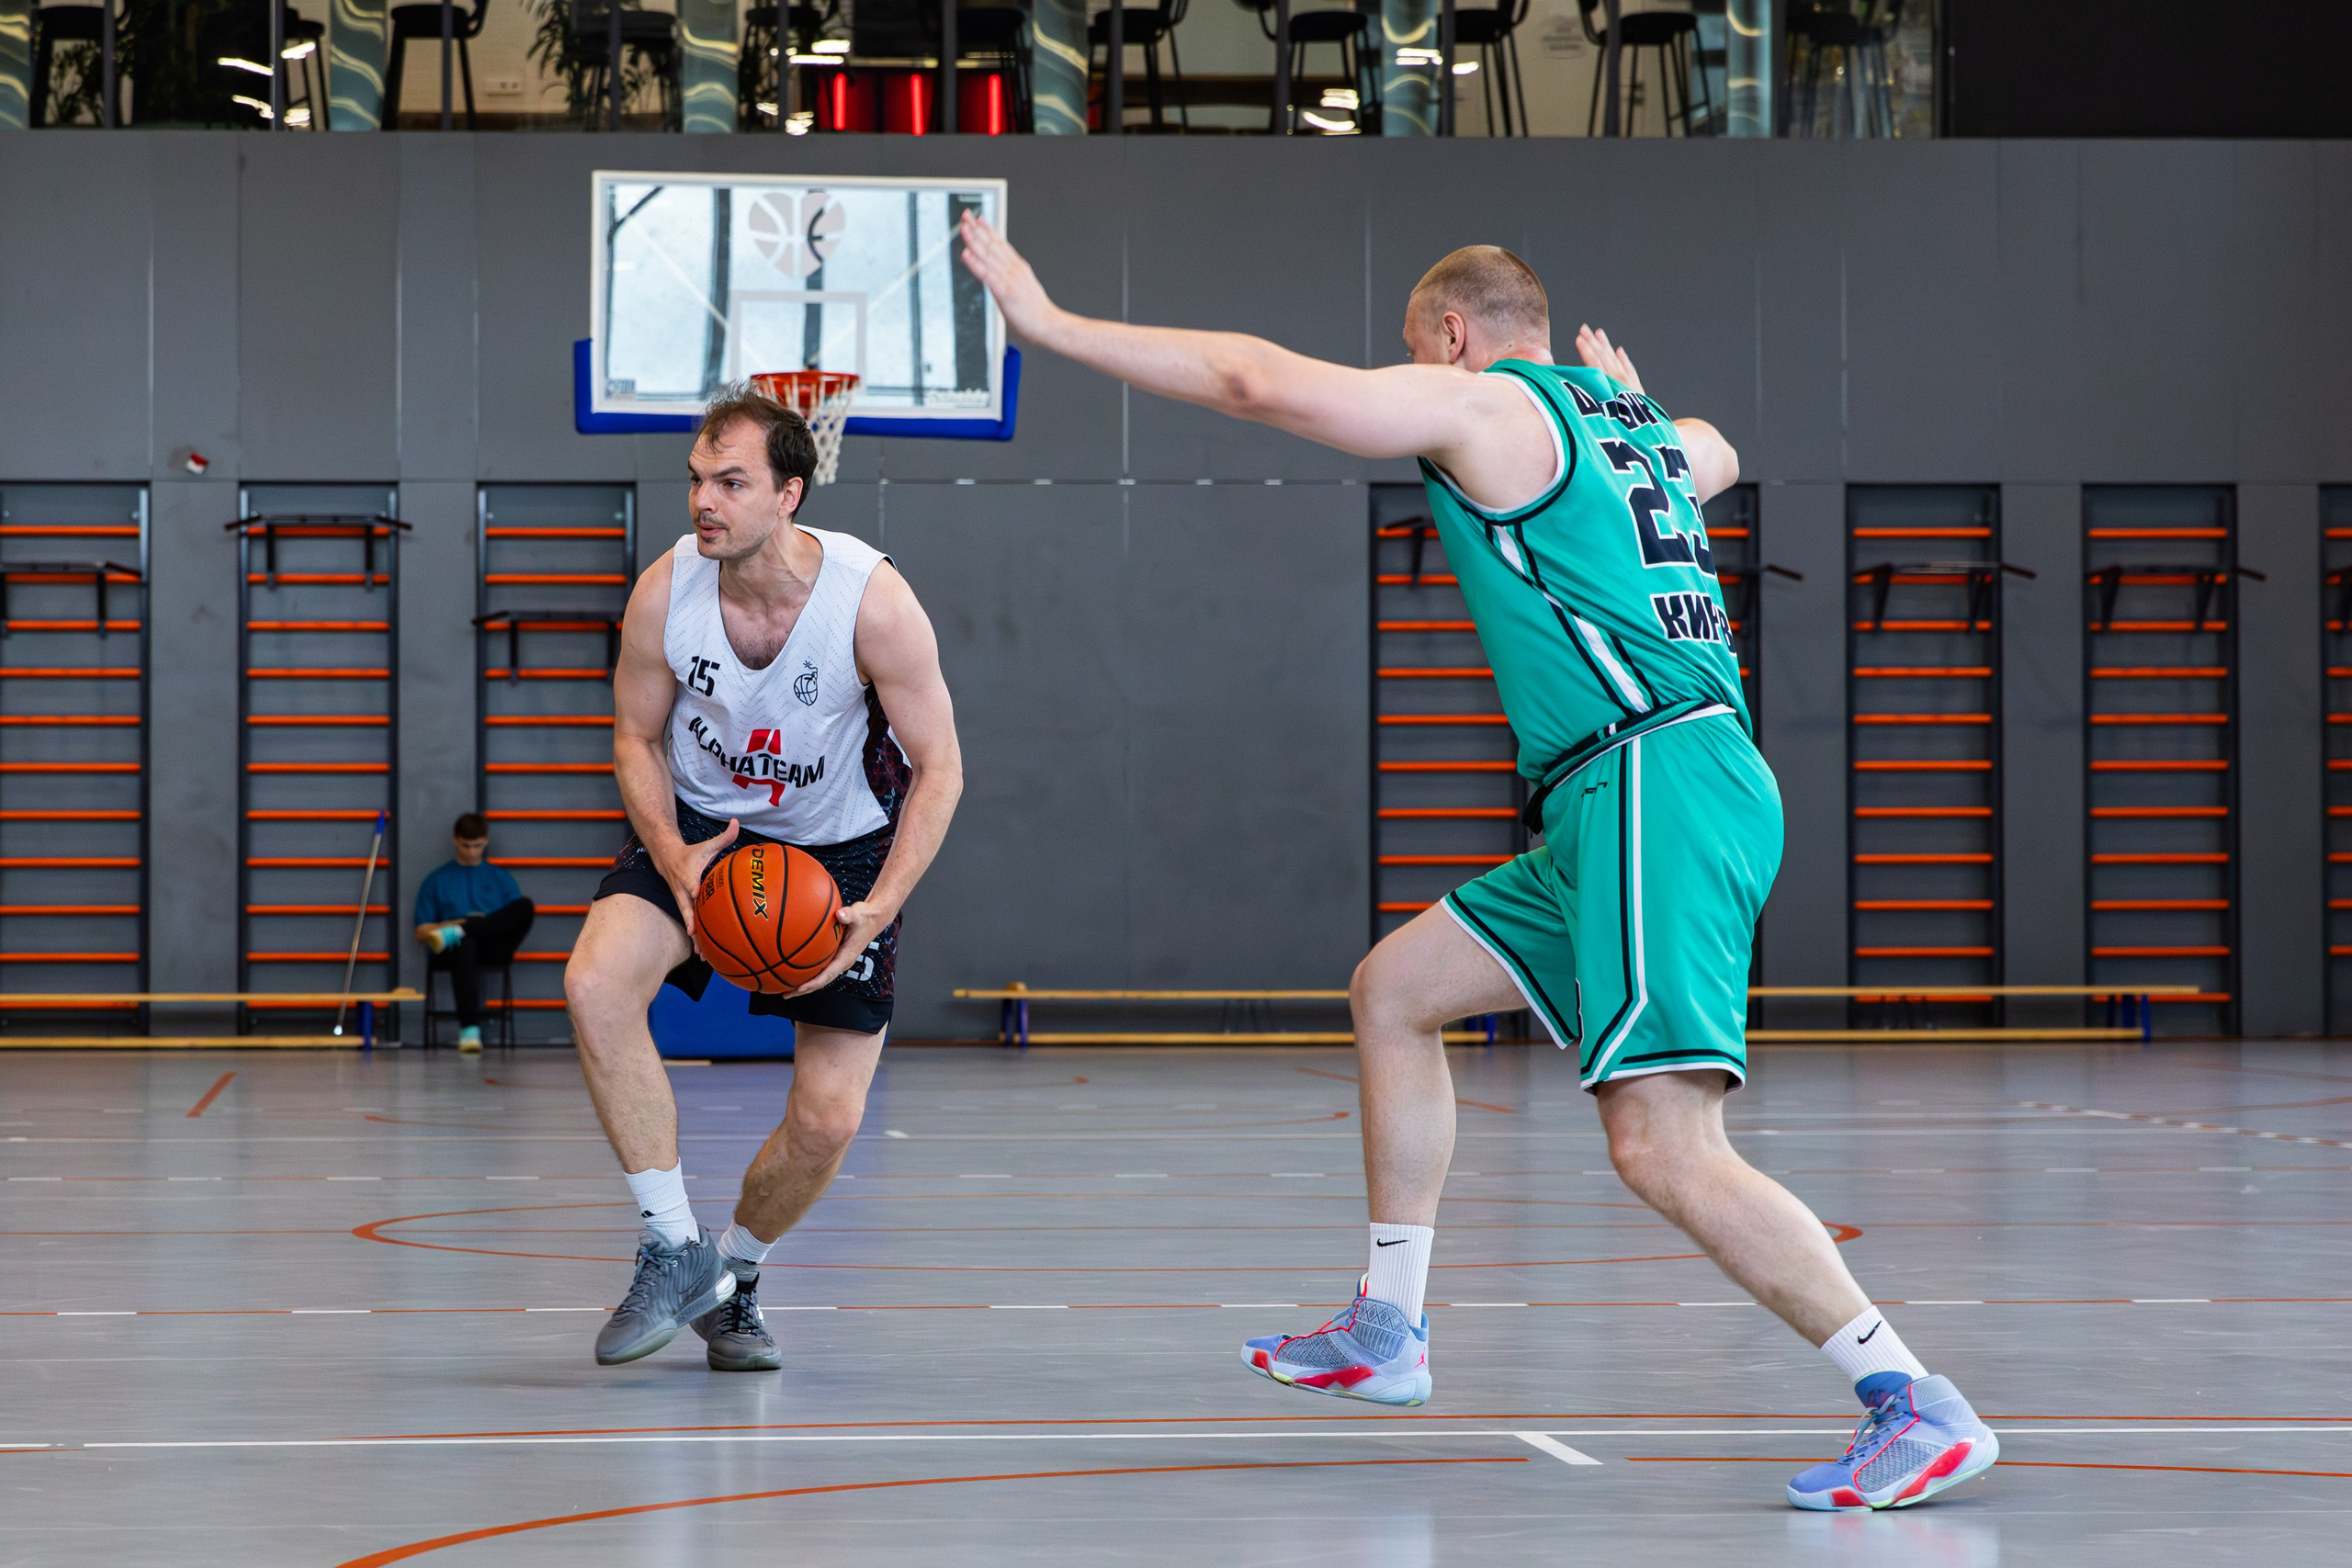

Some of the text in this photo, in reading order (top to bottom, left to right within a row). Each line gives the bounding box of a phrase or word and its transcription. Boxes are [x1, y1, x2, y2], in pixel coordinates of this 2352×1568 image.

[687, 655, 721, 698] 15
[687, 716, 826, 789] ALPHATEAM
[750, 848, 770, 921] DEMIX
